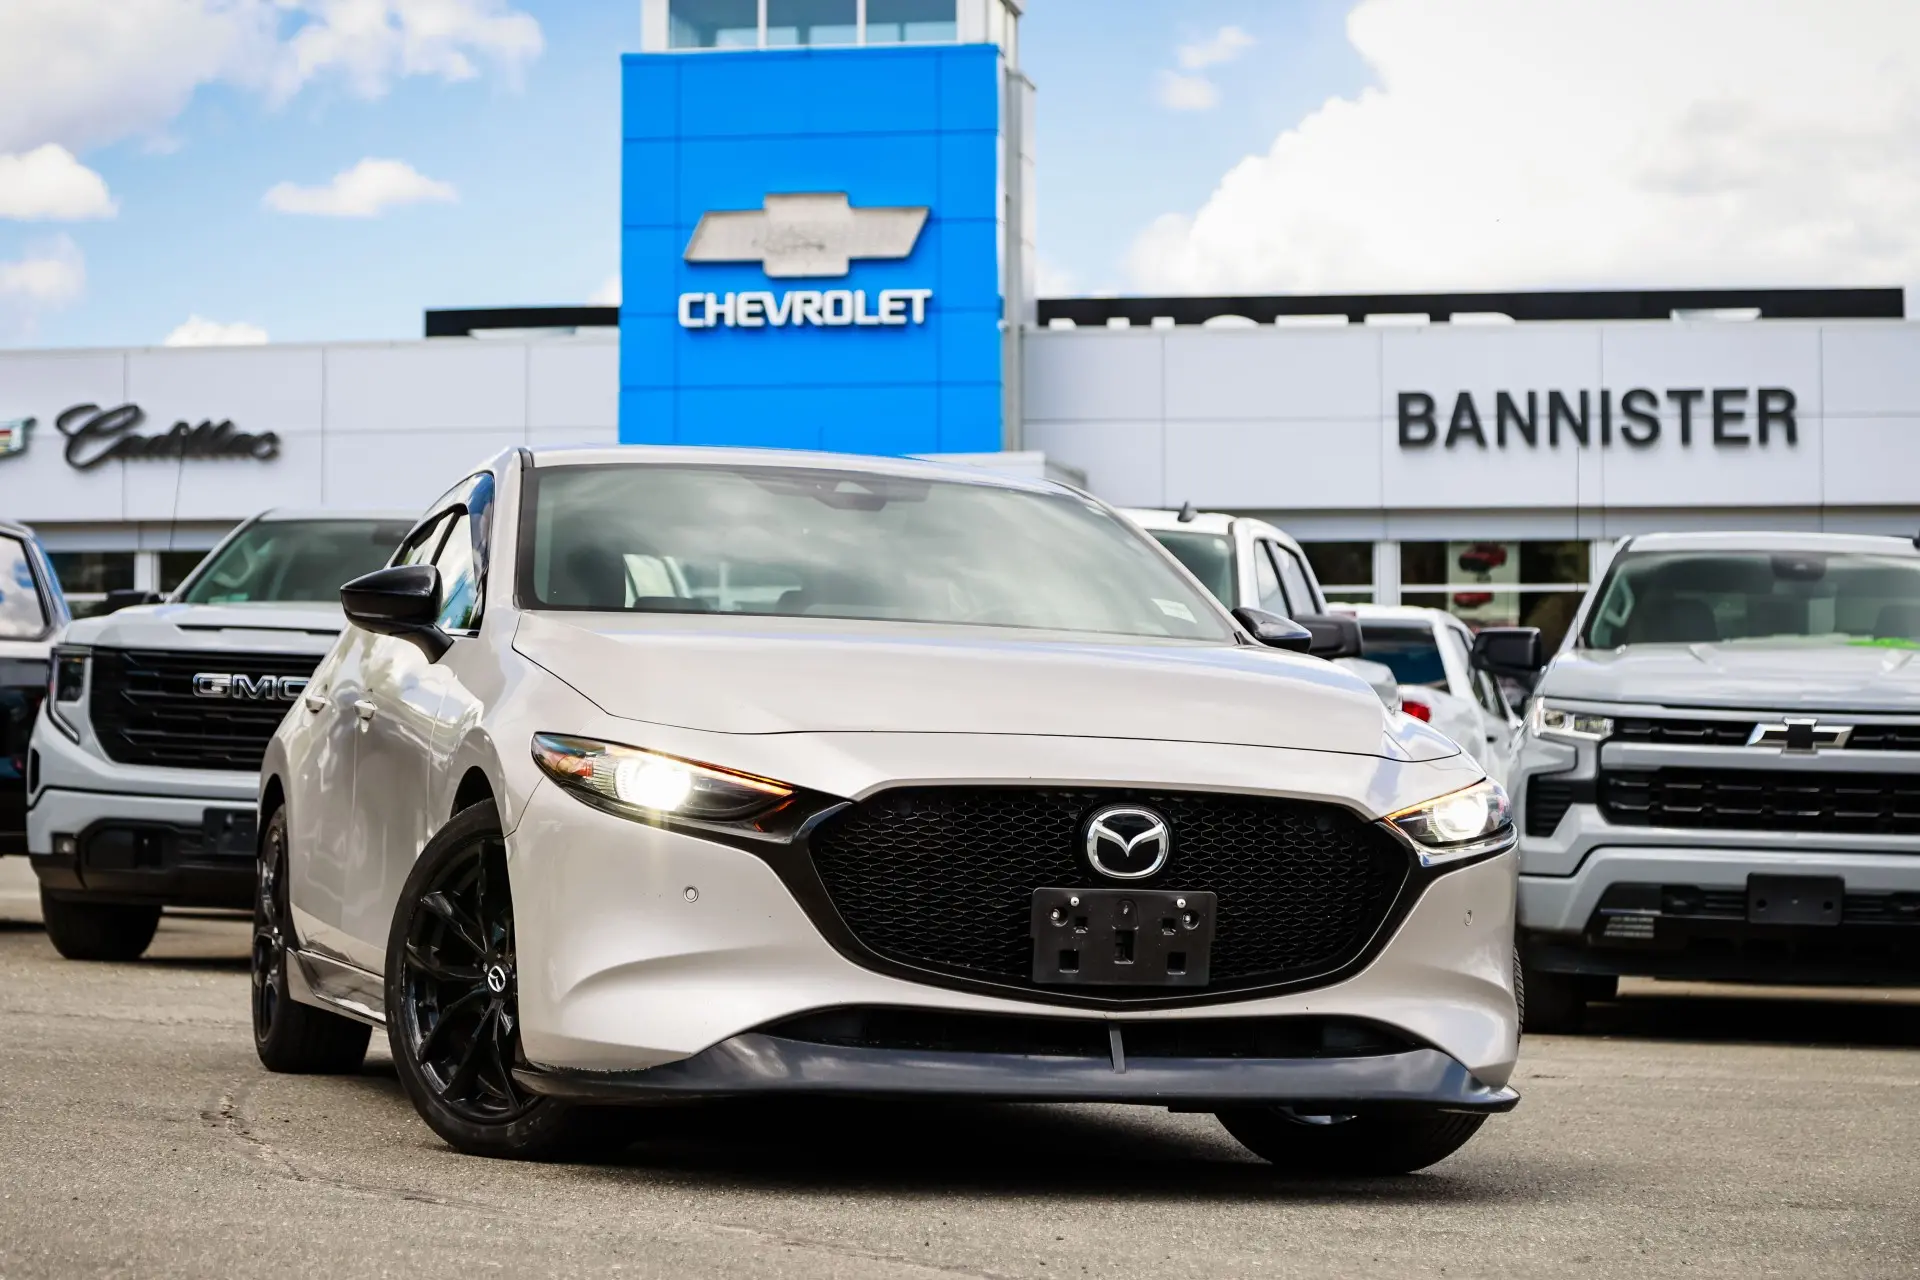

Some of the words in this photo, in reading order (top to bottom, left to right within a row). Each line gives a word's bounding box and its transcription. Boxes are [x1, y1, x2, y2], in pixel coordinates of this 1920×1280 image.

[678, 288, 933, 328] CHEVROLET
[1397, 387, 1799, 448] BANNISTER
[192, 672, 311, 701] GMC
